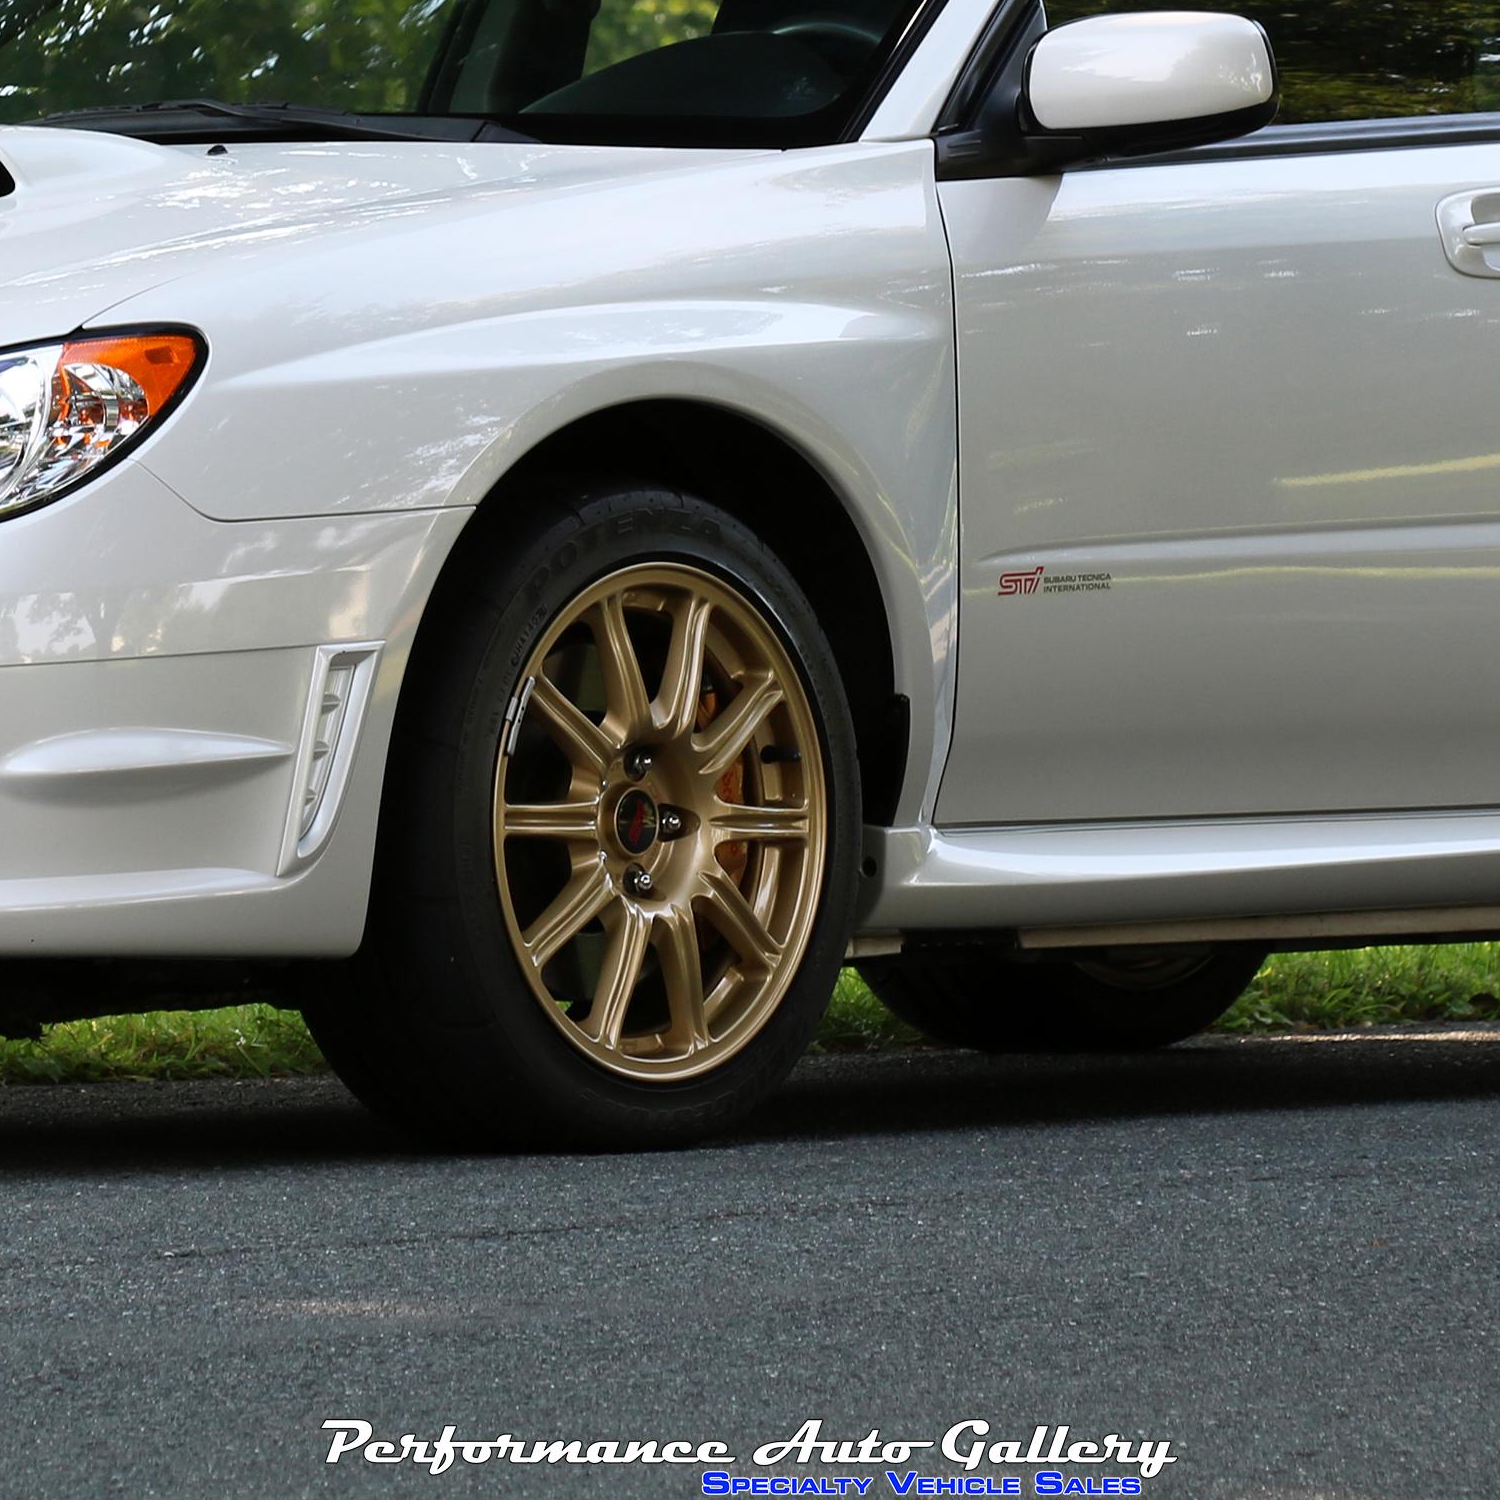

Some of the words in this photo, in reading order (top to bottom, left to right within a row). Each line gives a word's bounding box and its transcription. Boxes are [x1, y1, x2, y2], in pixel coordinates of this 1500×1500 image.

[1044, 575, 1077, 583] SUBARU
[1078, 573, 1111, 582] TECNICA
[1044, 583, 1111, 593] INTERNATIONAL
